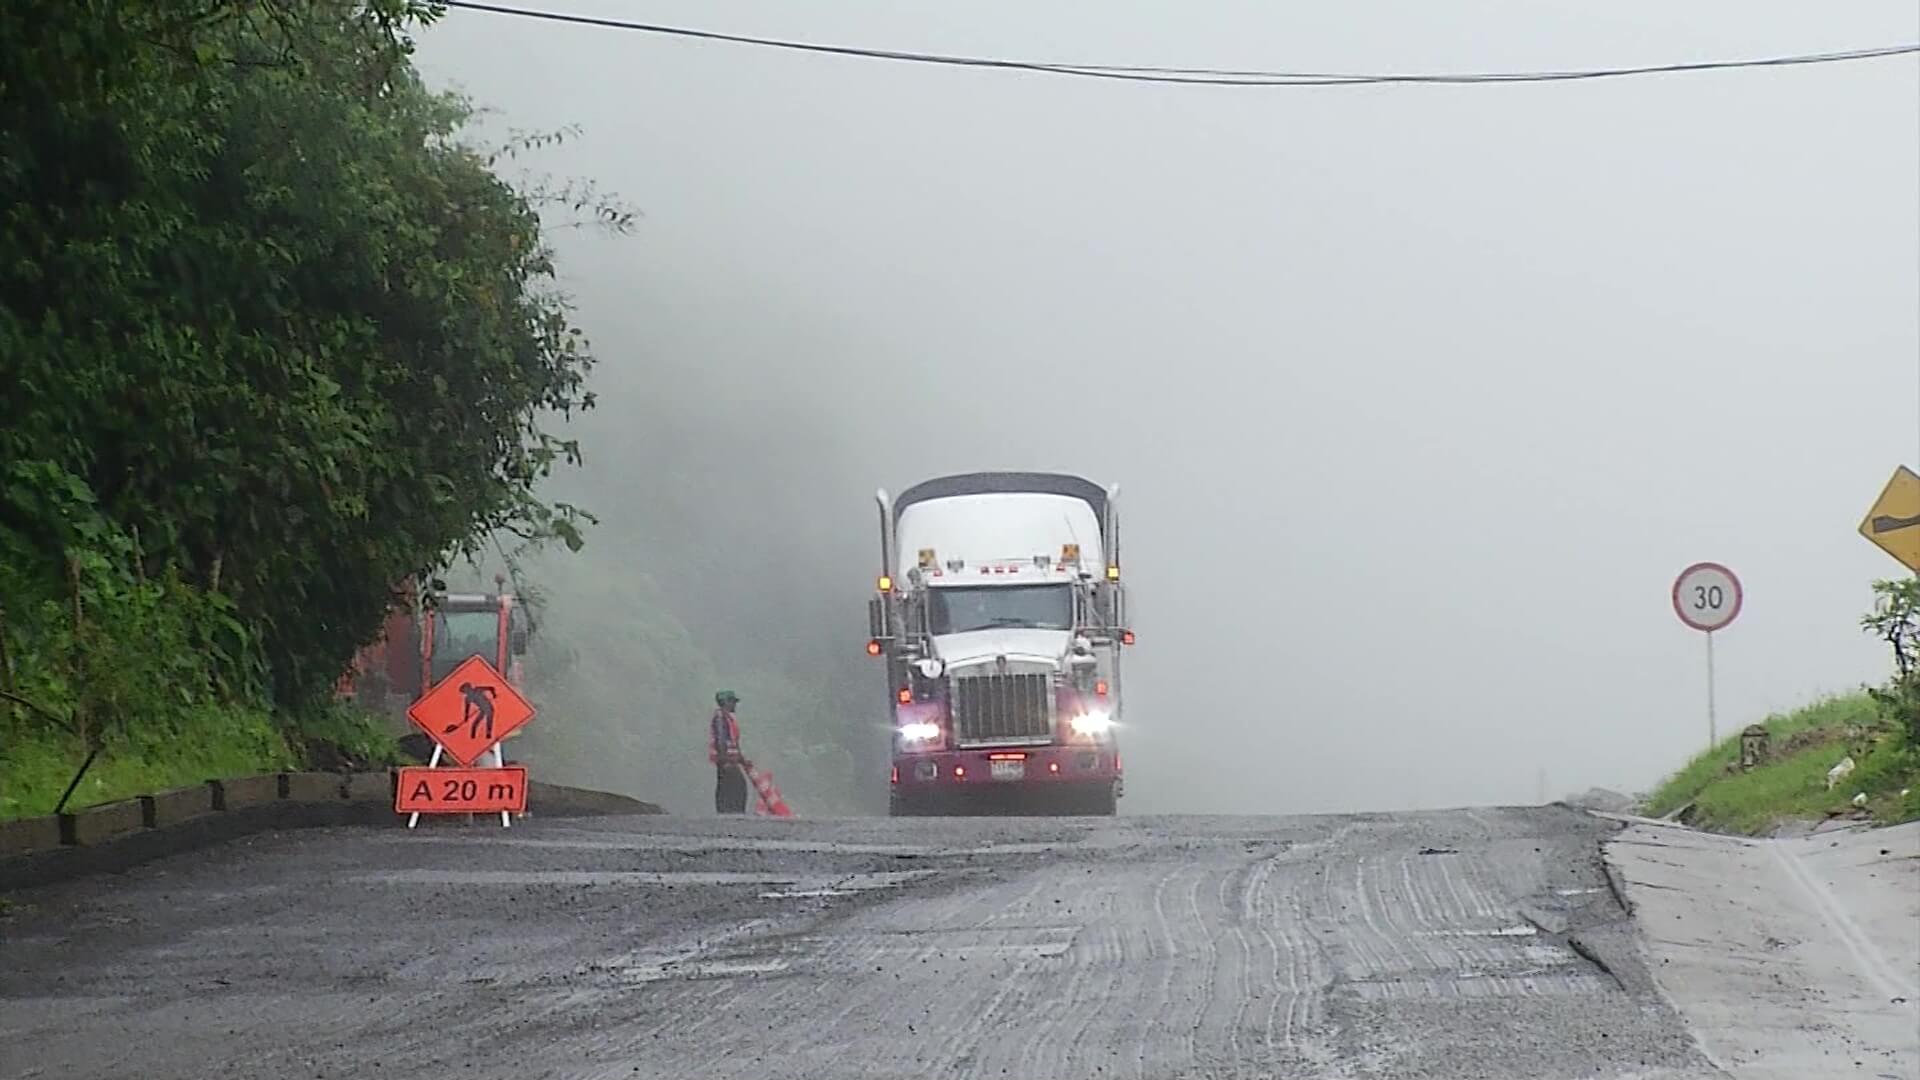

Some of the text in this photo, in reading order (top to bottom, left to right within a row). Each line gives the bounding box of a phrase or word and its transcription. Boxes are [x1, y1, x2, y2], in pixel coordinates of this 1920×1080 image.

[1694, 585, 1723, 609] 30
[410, 780, 514, 802] A 20 m
